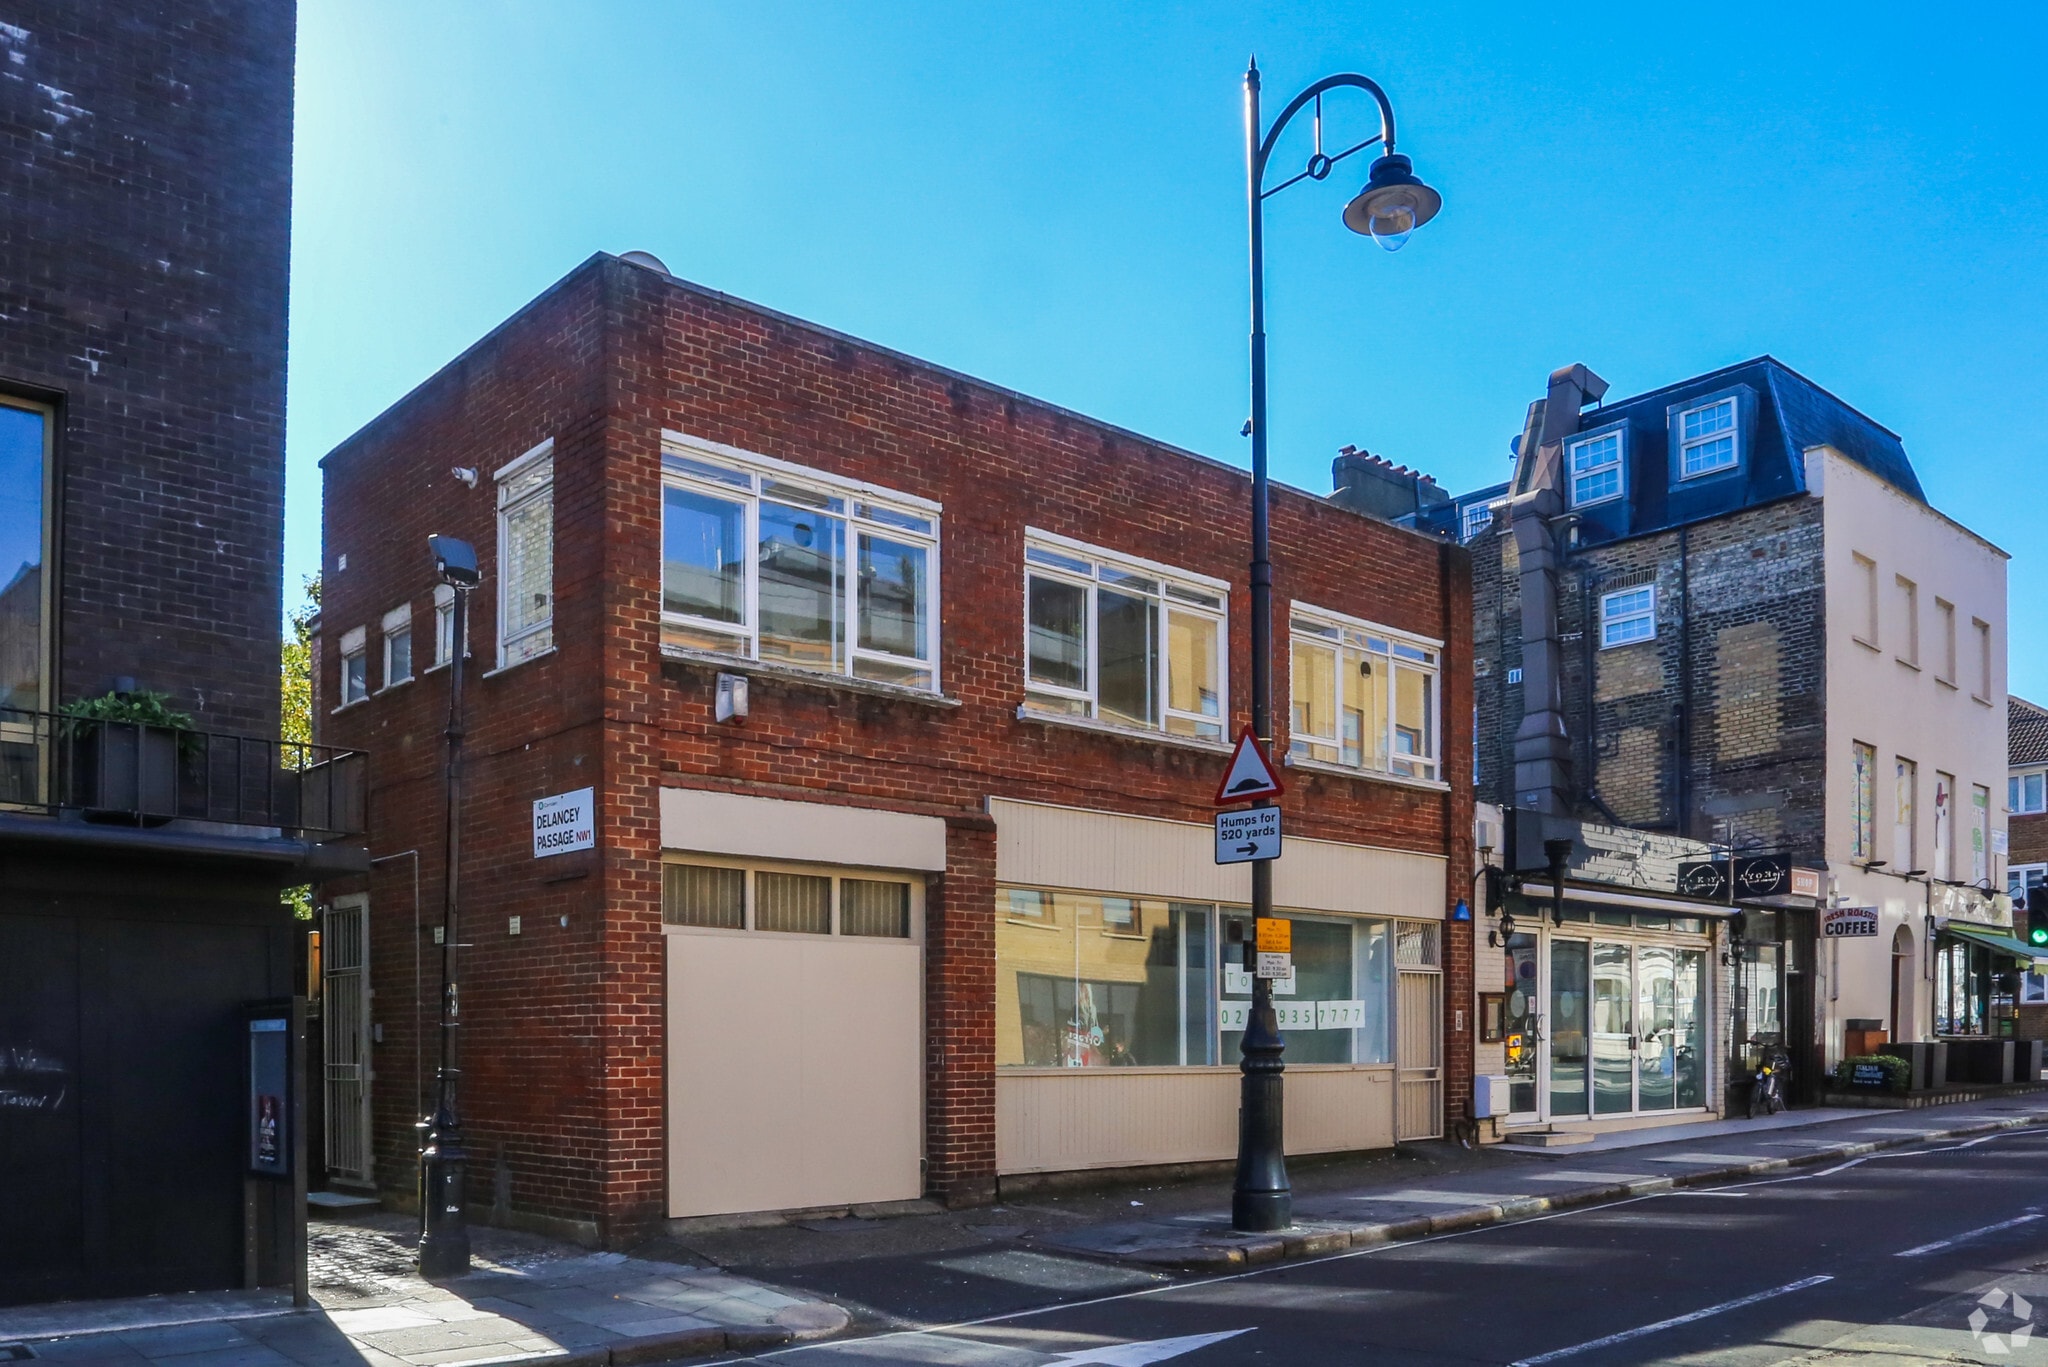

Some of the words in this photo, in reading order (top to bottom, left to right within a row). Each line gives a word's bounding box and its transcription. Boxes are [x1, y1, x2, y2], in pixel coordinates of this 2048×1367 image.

[537, 807, 580, 829] DELANCEY
[1220, 816, 1257, 828] Humps
[1260, 813, 1276, 823] for
[537, 830, 574, 850] PASSAGE
[576, 830, 591, 842] NW1
[1221, 828, 1242, 840] 520
[1246, 826, 1275, 840] yards
[1796, 877, 1813, 888] SHOP
[1824, 909, 1845, 922] FRESH
[1847, 908, 1878, 921] ROASTED
[1825, 921, 1876, 935] COFFEE
